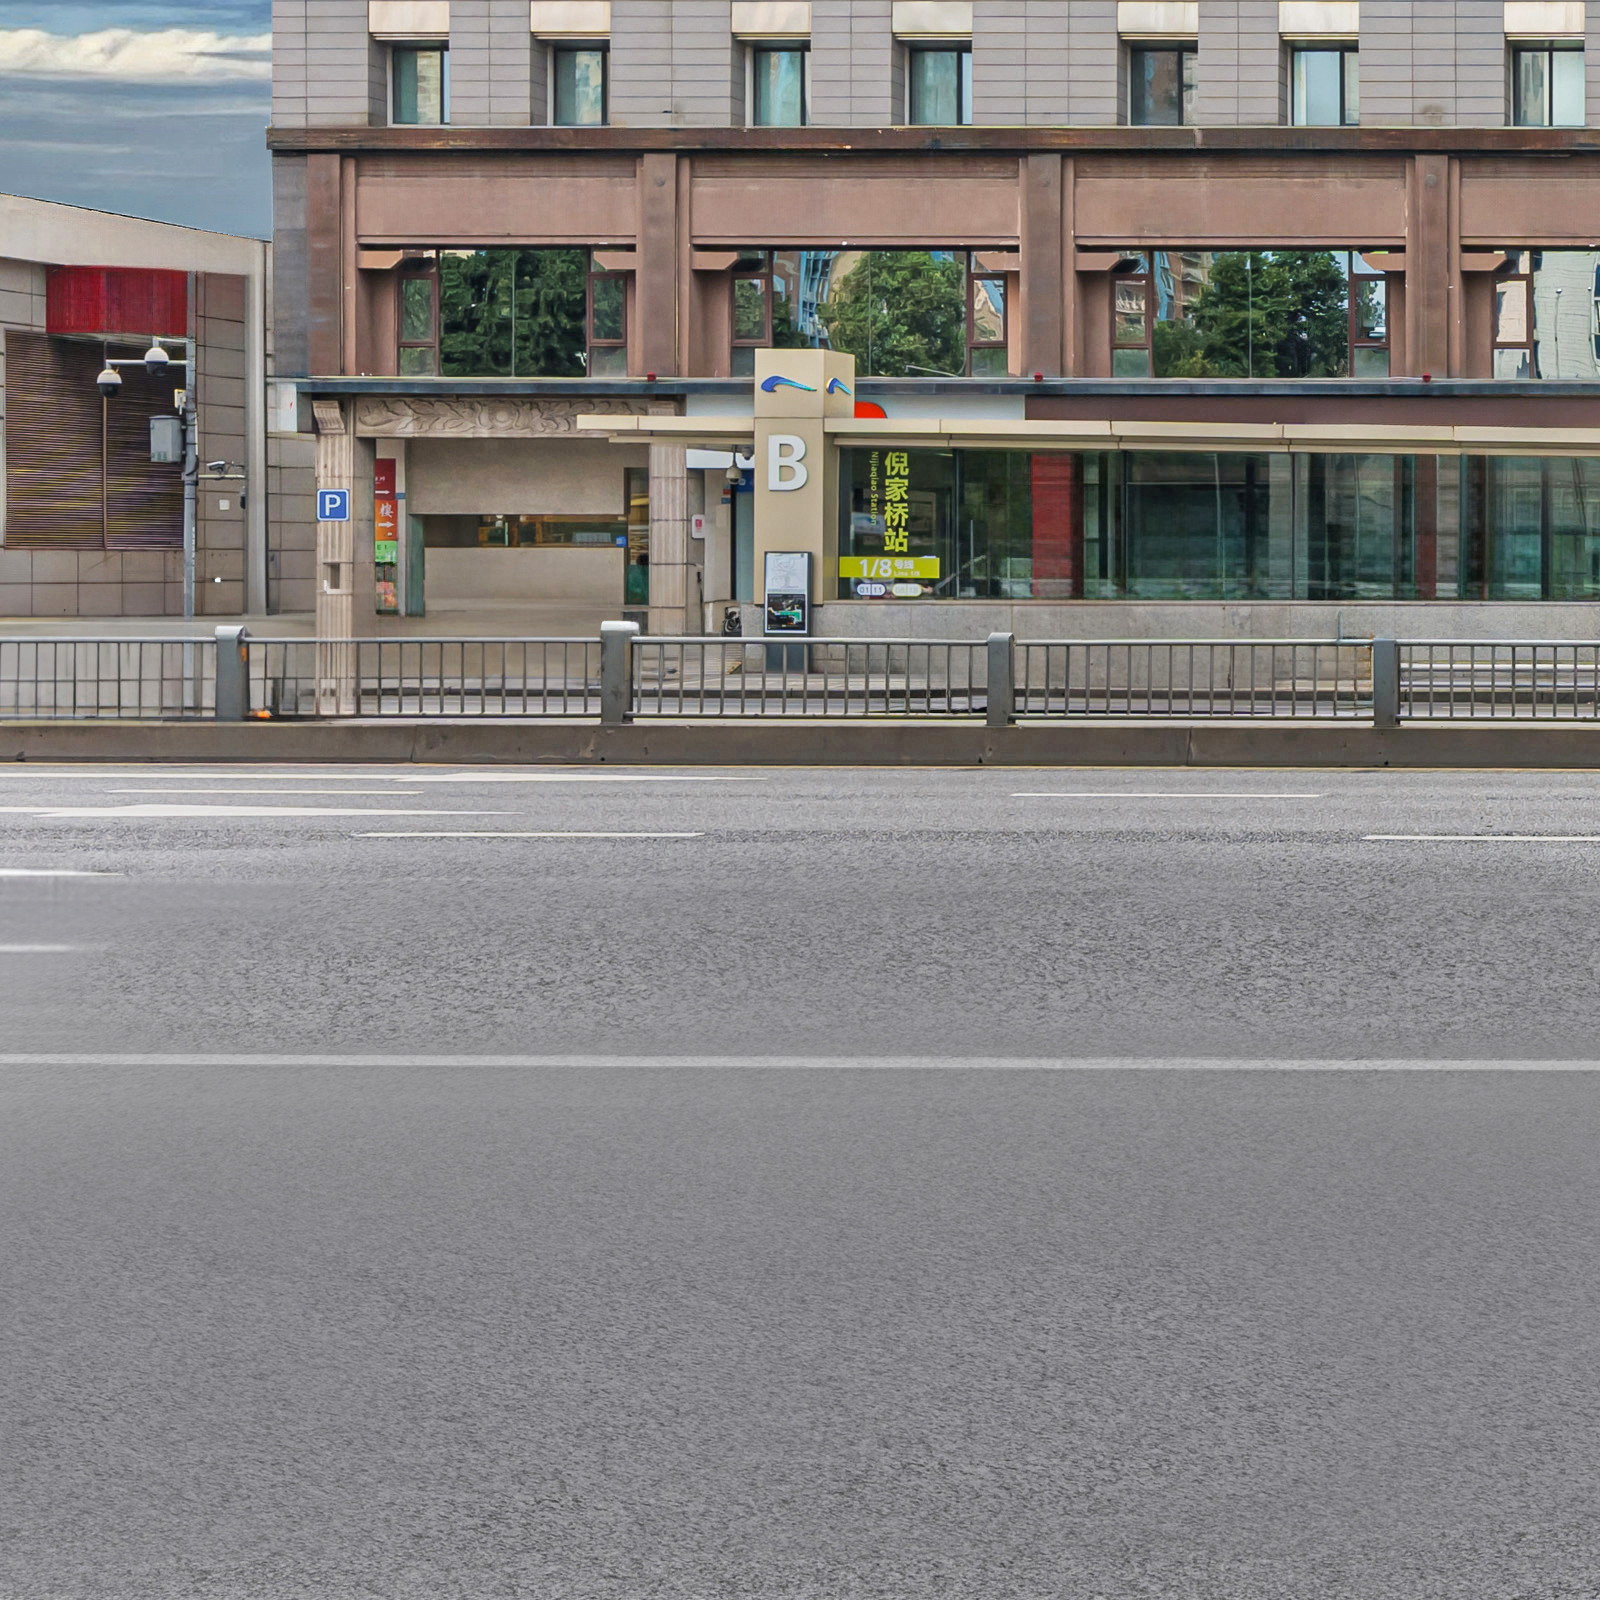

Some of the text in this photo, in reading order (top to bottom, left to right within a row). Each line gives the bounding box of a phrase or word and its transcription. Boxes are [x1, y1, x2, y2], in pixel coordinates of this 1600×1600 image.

[768, 434, 808, 492] B
[869, 451, 879, 526] Nijiaqiao Station
[325, 494, 341, 516] P
[884, 451, 909, 553] 倪家桥站
[860, 559, 892, 577] 1/8
